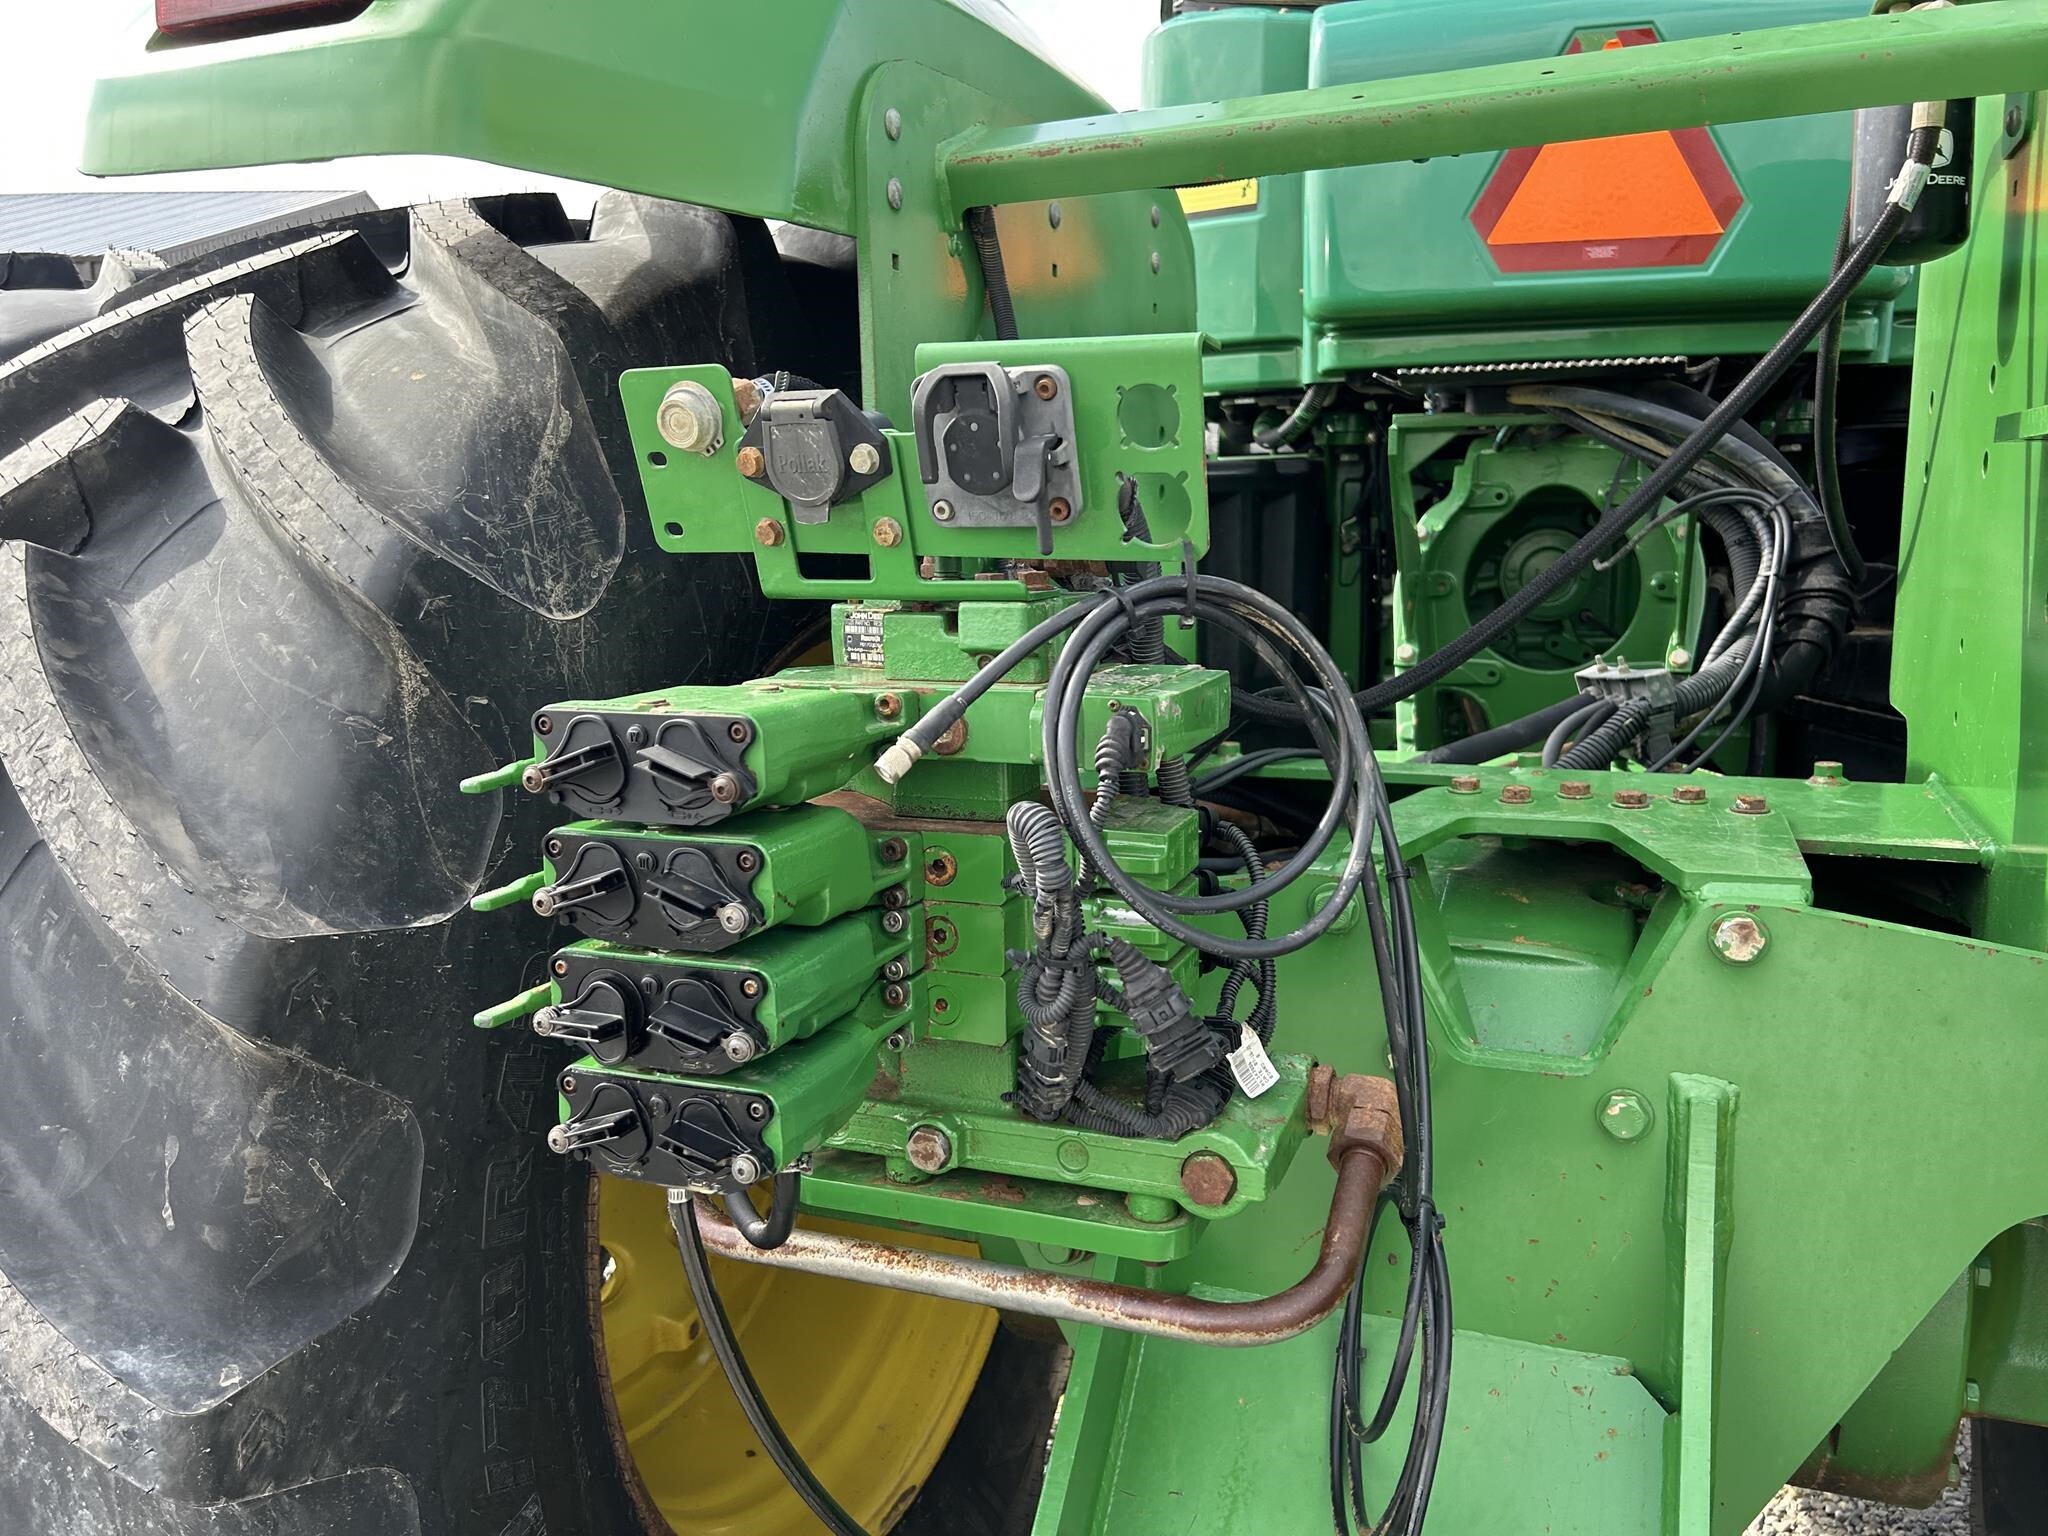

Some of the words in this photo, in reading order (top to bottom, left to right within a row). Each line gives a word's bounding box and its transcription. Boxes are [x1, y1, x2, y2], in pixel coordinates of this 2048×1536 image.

[1927, 173, 1966, 186] DEERE
[778, 453, 828, 474] Pollak
[850, 612, 867, 620] JOHN
